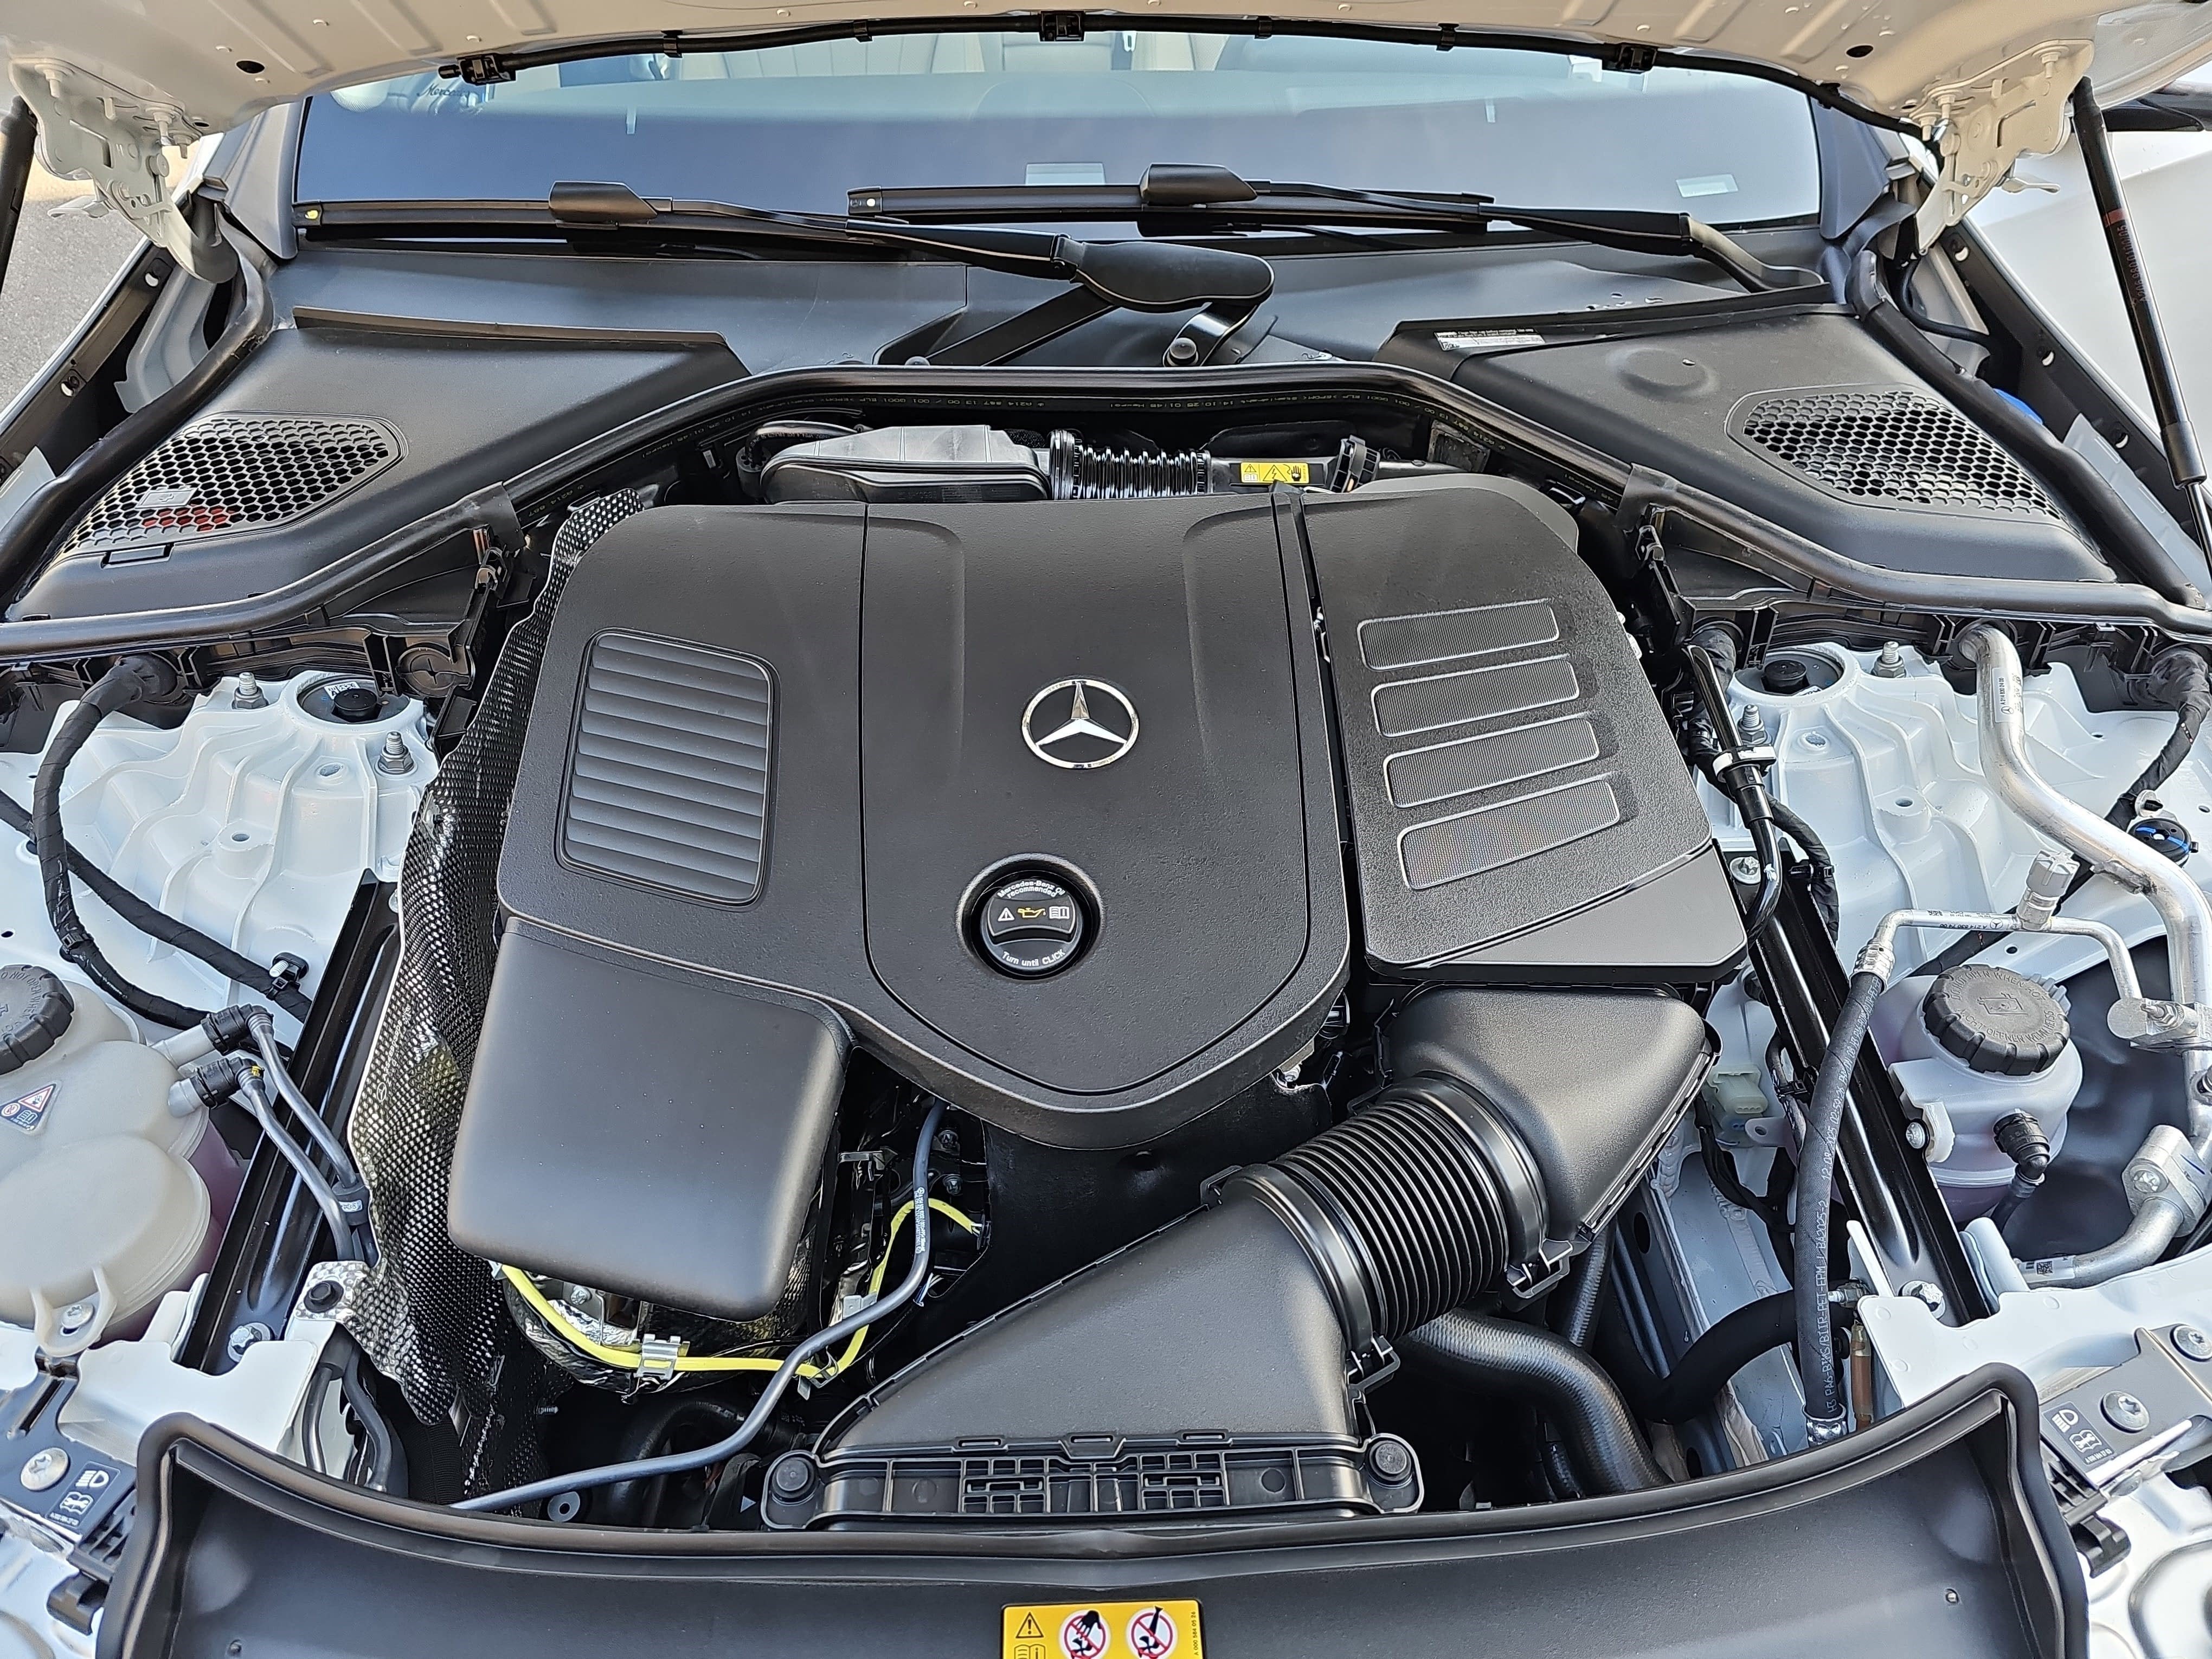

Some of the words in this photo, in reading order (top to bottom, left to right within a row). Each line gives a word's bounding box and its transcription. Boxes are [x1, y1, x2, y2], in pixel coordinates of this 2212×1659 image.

[997, 880, 1055, 898] Mercedes-Benz
[1056, 887, 1066, 896] Oil
[1007, 886, 1057, 898] recommended
[1002, 951, 1019, 965] Turn
[1021, 959, 1039, 967] until
[1041, 949, 1066, 965] CLICK
[26, 978, 42, 995] OPEN
[1992, 972, 2025, 988] WHEN
[1825, 1398, 1838, 1413] H3
